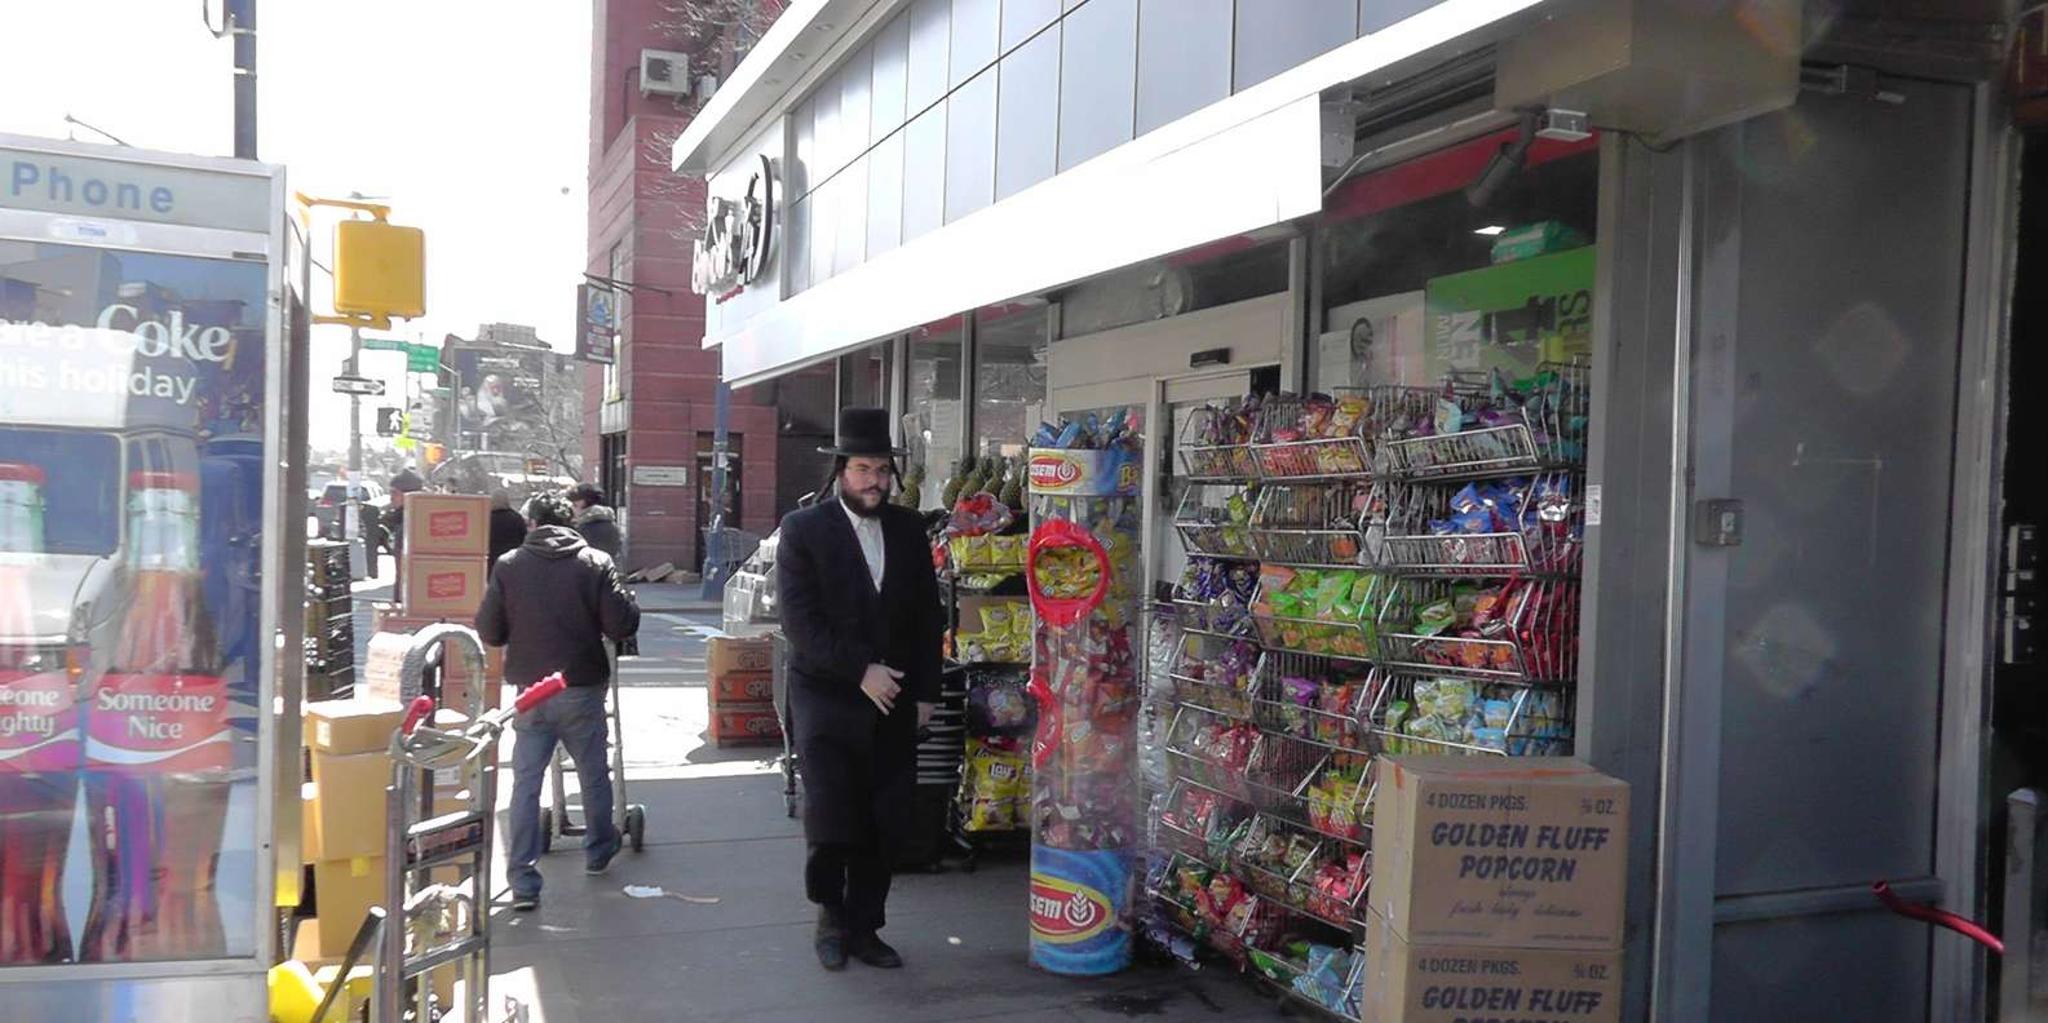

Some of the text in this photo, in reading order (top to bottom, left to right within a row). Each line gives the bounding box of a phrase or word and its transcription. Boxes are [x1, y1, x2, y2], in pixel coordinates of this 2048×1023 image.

[12, 161, 174, 213] Phone
[97, 303, 231, 362] Coke
[58, 358, 196, 404] holiday
[98, 687, 215, 713] Someone
[127, 716, 183, 739] Nice
[1427, 794, 1529, 811] 4 DOZEN PKGS.
[1432, 822, 1610, 851] GOLDEN FLUFF
[1459, 855, 1577, 882] POPCORN
[1418, 958, 1521, 974] 4 DOZEN PKGS.
[1422, 986, 1603, 1014] GOLDEN FLUFF
